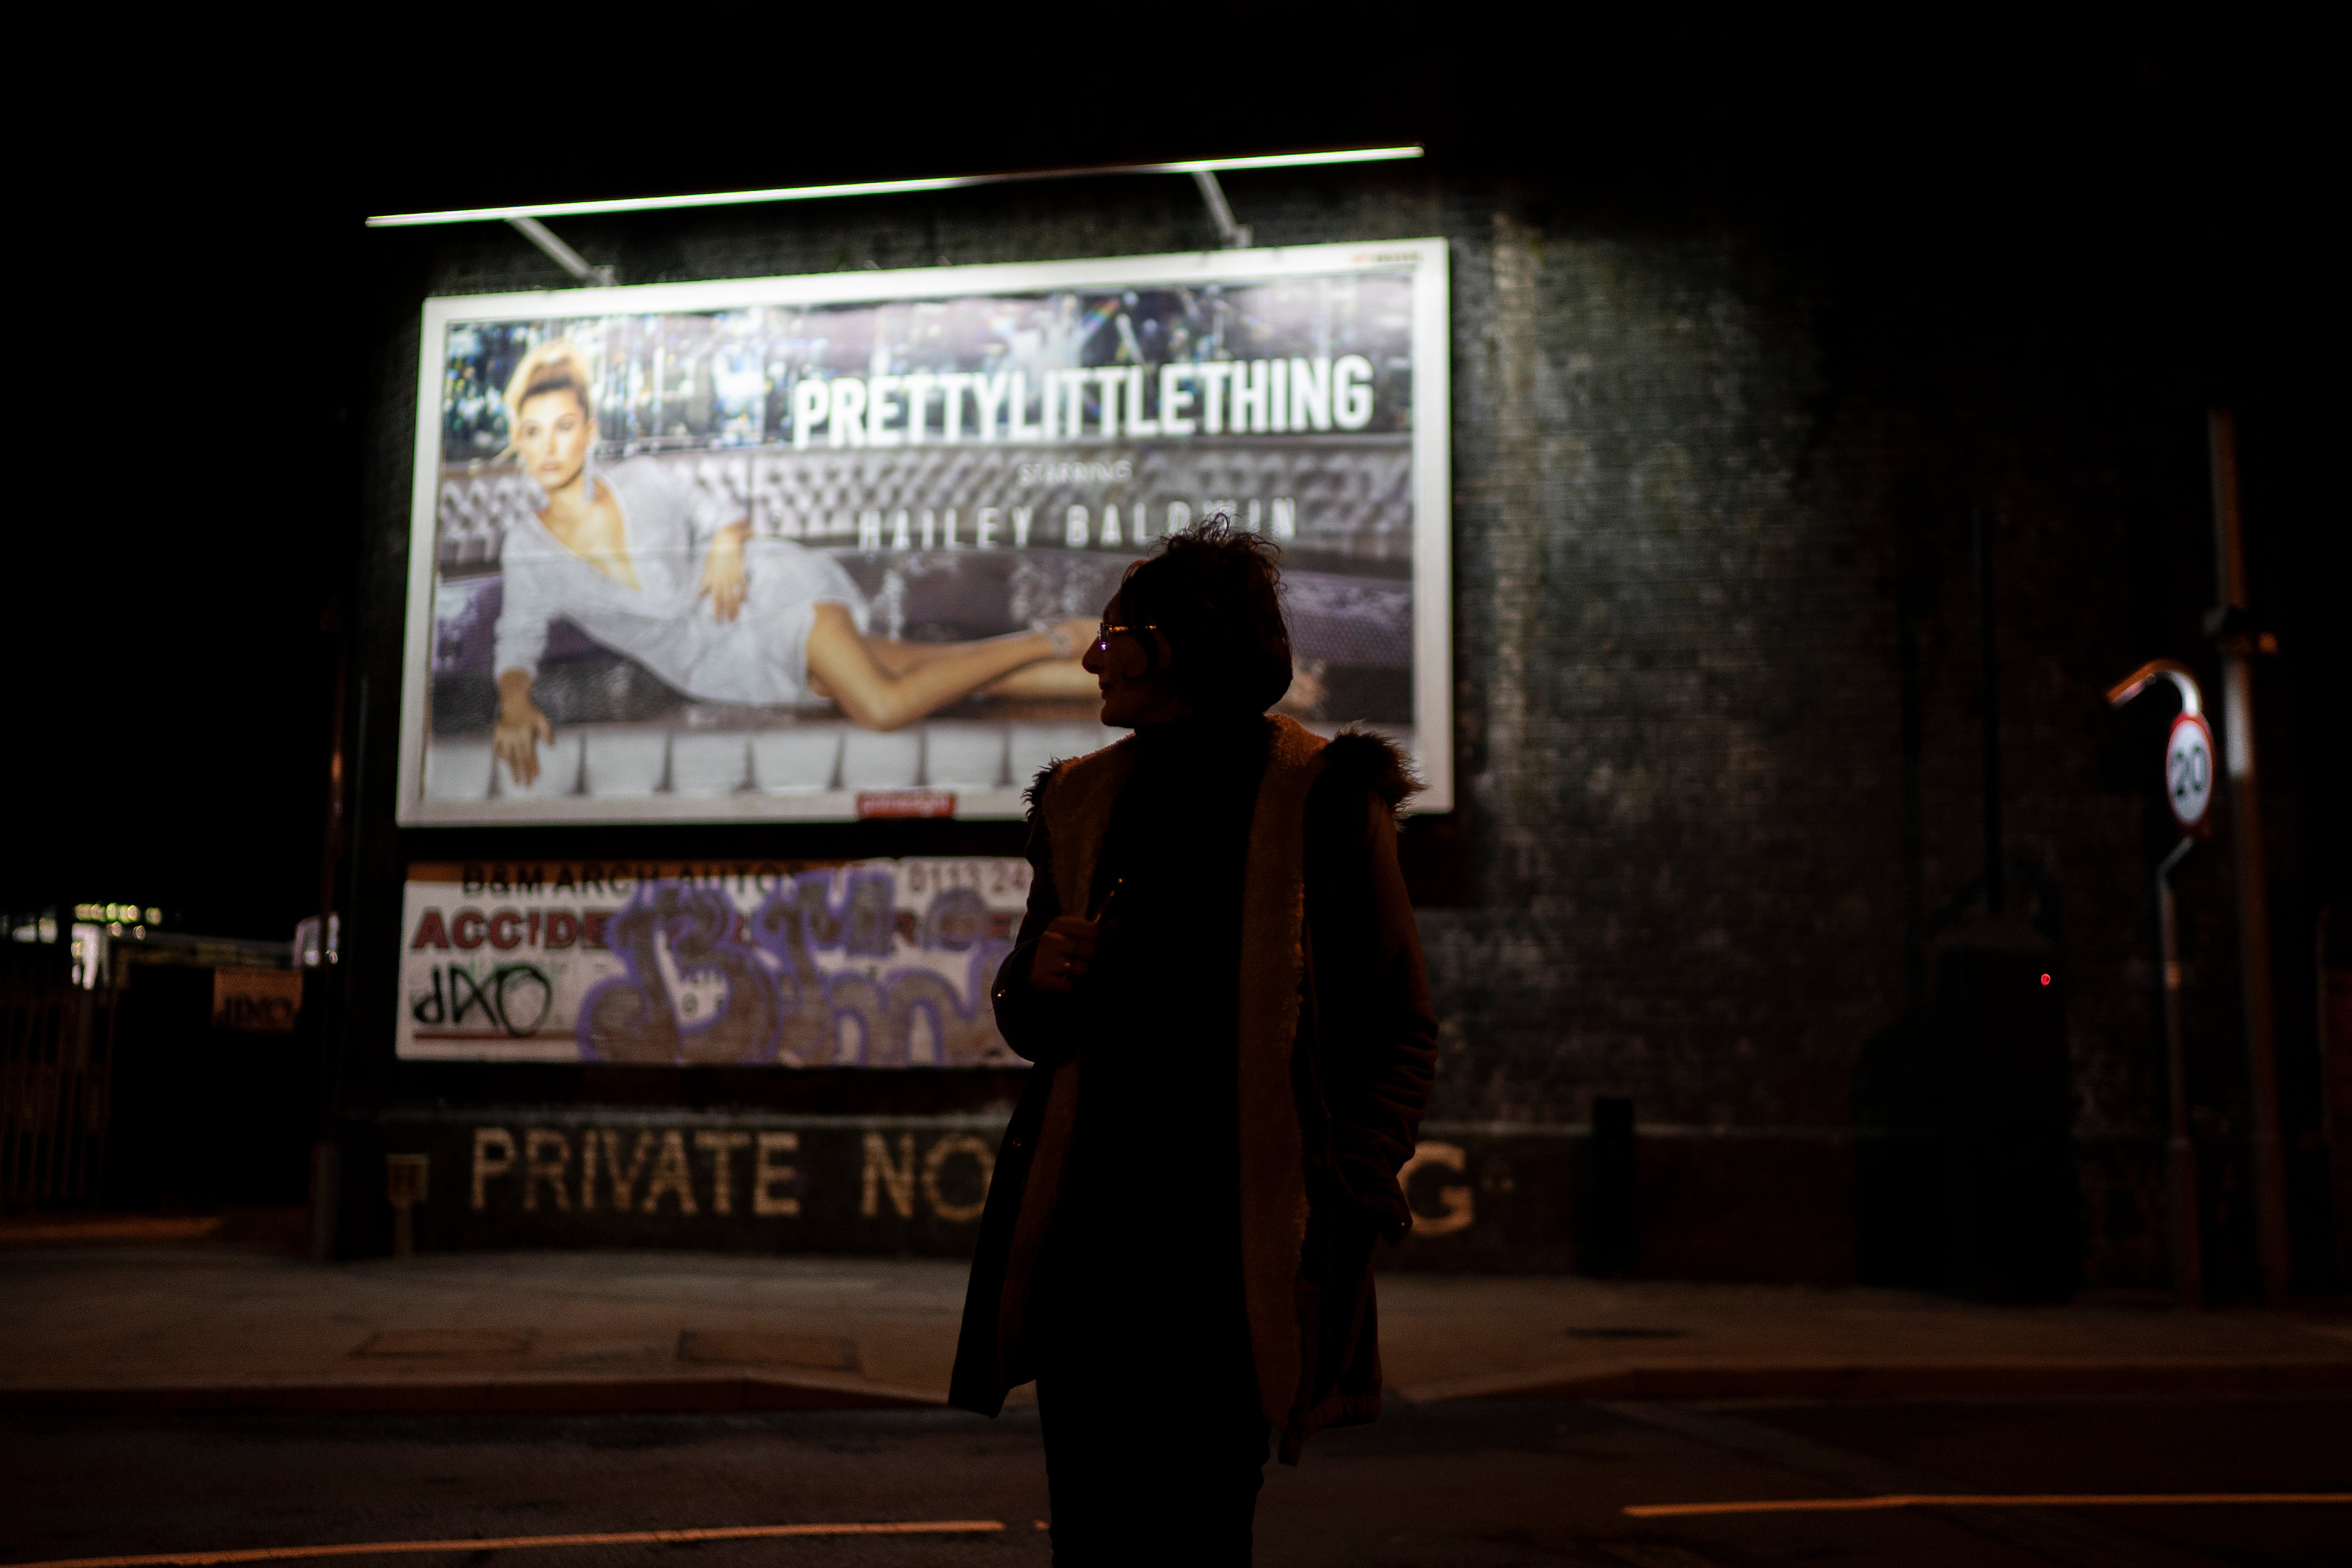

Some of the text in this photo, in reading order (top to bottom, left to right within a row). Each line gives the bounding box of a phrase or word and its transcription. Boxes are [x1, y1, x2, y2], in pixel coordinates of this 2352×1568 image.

[791, 355, 1374, 450] PRETTYLITTLETHING
[1018, 459, 1133, 483] STARRING
[857, 507, 1033, 551] HAILEY
[2172, 744, 2206, 796] 20
[464, 858, 544, 894] B&M
[412, 908, 608, 949] ACCIDE
[471, 1126, 997, 1223] PRIVATE NO
